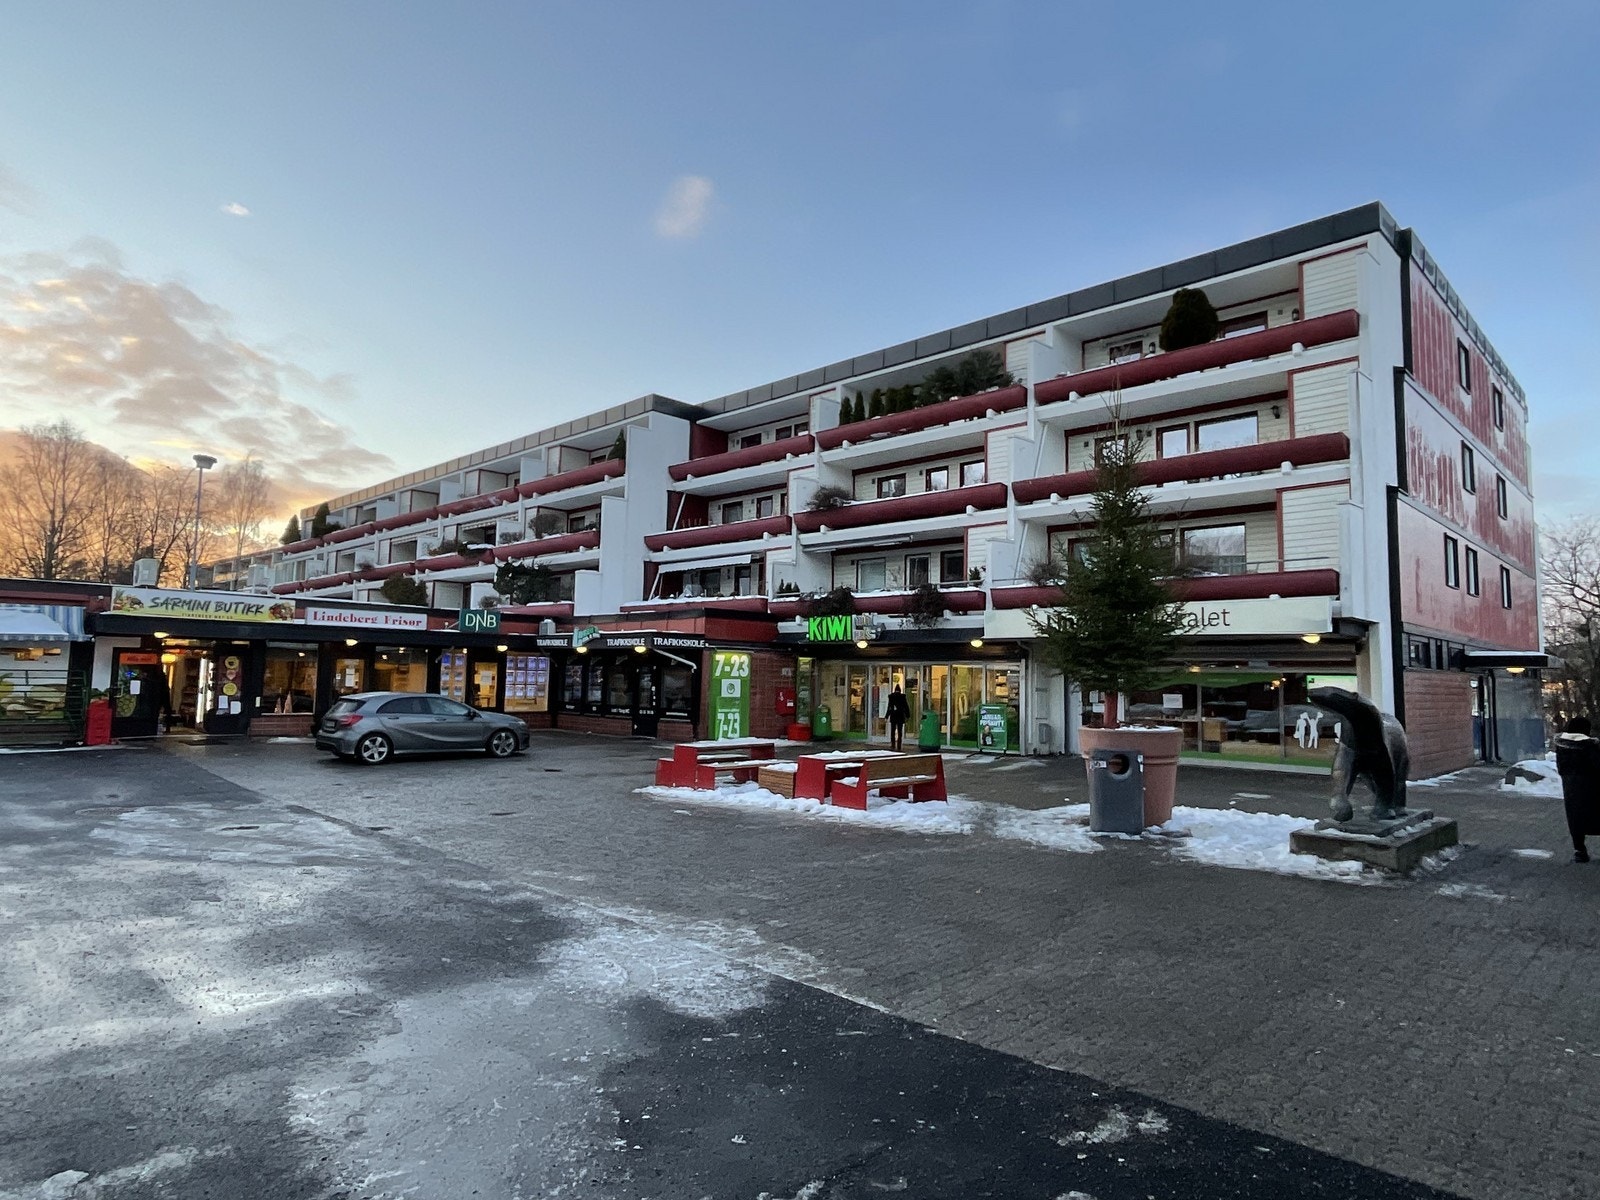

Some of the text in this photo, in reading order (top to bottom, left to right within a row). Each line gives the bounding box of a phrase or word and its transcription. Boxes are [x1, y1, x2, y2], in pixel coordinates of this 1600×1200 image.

[148, 597, 265, 616] SARMINI BUTIKK
[313, 611, 378, 624] Lindeberg
[465, 610, 497, 632] DNB
[809, 615, 852, 641] KIWI
[607, 638, 645, 646] TRAFIKKSKOLE
[653, 637, 705, 647] TRAFIKKSKOLE
[715, 654, 749, 677] 7-23
